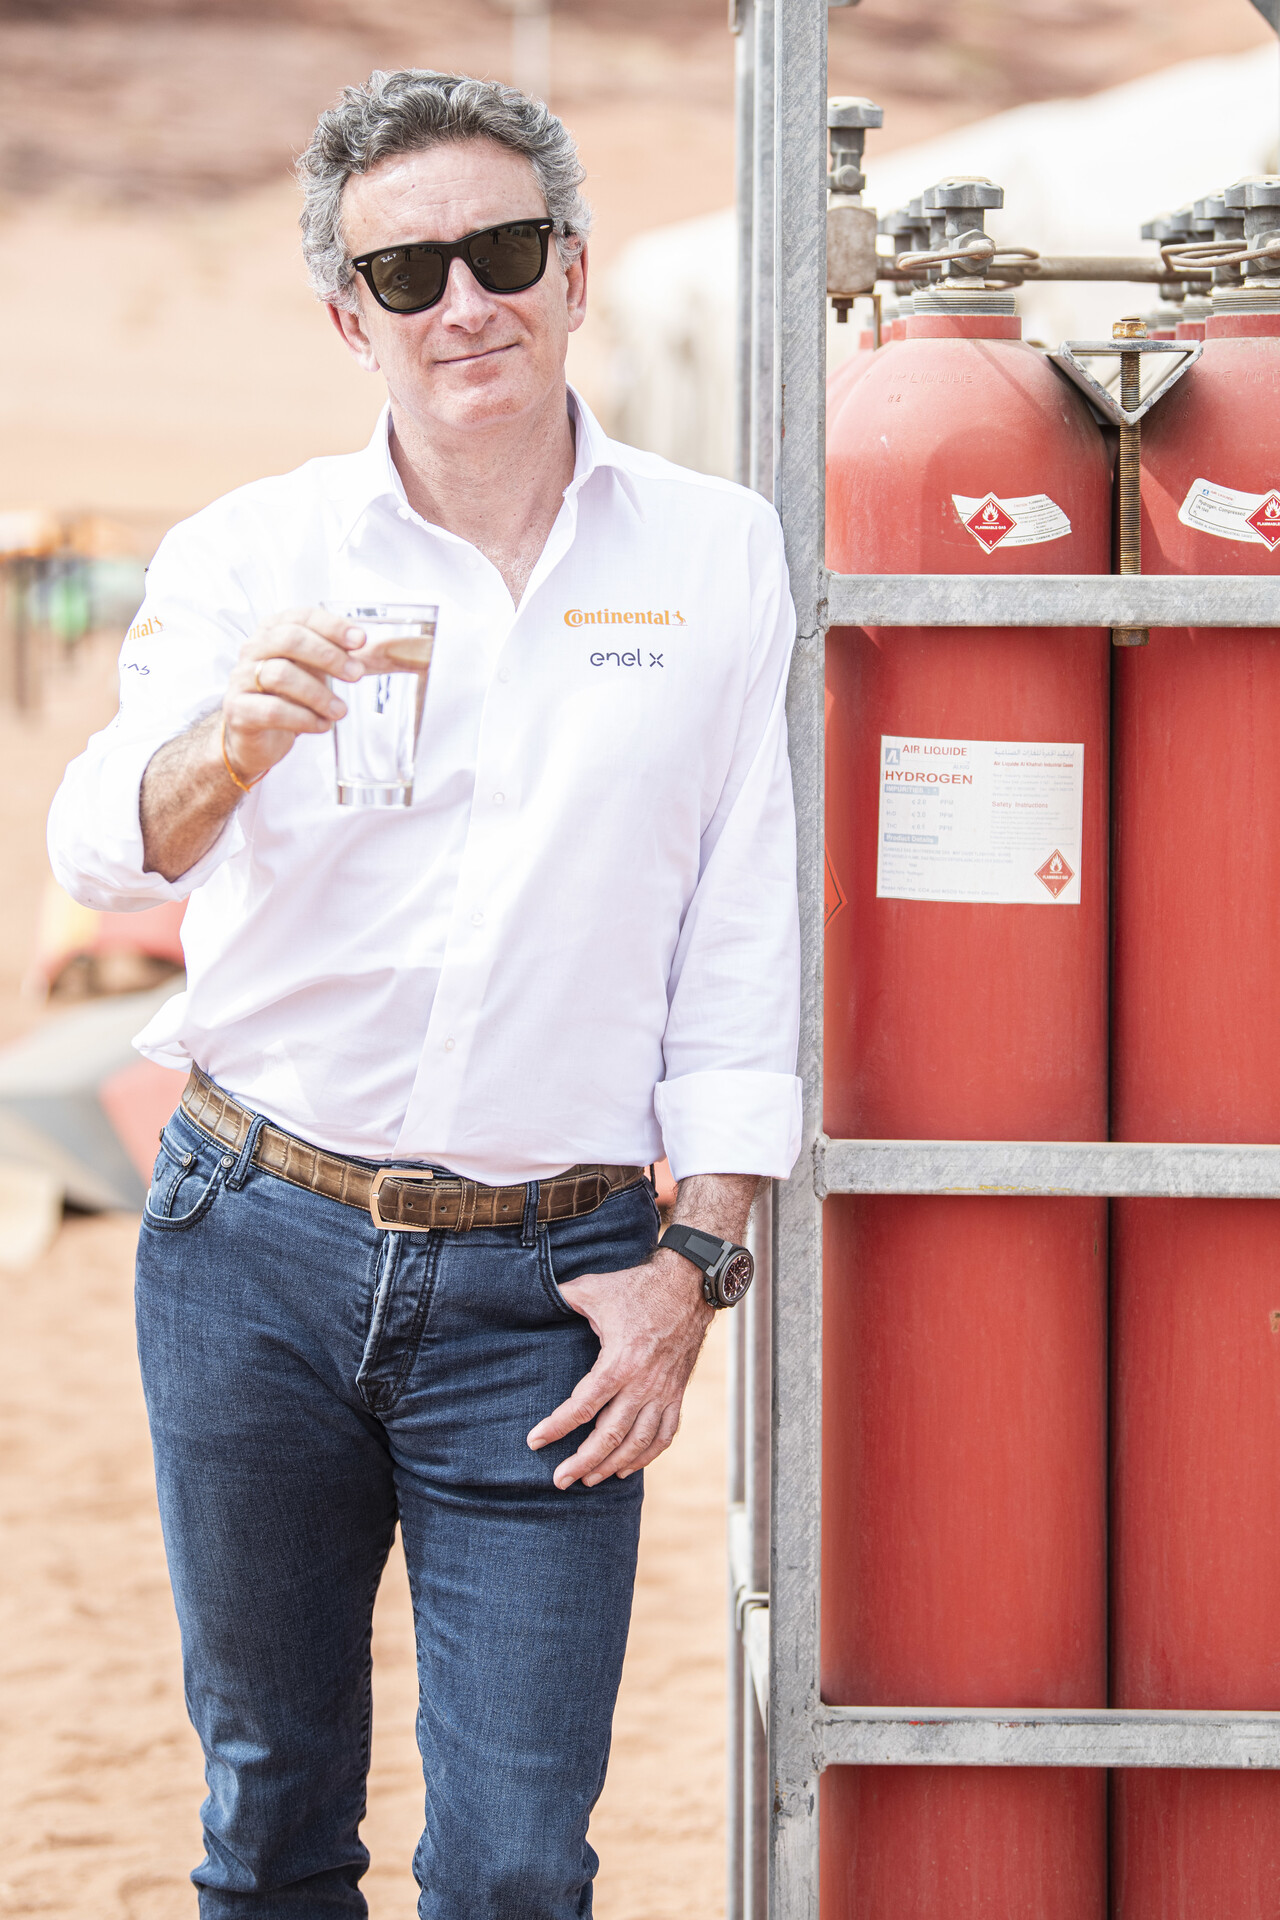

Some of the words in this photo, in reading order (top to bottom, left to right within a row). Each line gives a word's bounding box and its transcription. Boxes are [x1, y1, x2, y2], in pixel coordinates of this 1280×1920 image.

[564, 608, 671, 628] Continental
[590, 648, 642, 667] enel
[902, 744, 920, 754] AIR
[923, 745, 968, 756] LIQUIDE
[885, 770, 973, 785] HYDROGEN
[991, 800, 1012, 809] Safety
[1015, 801, 1048, 809] Instructions
